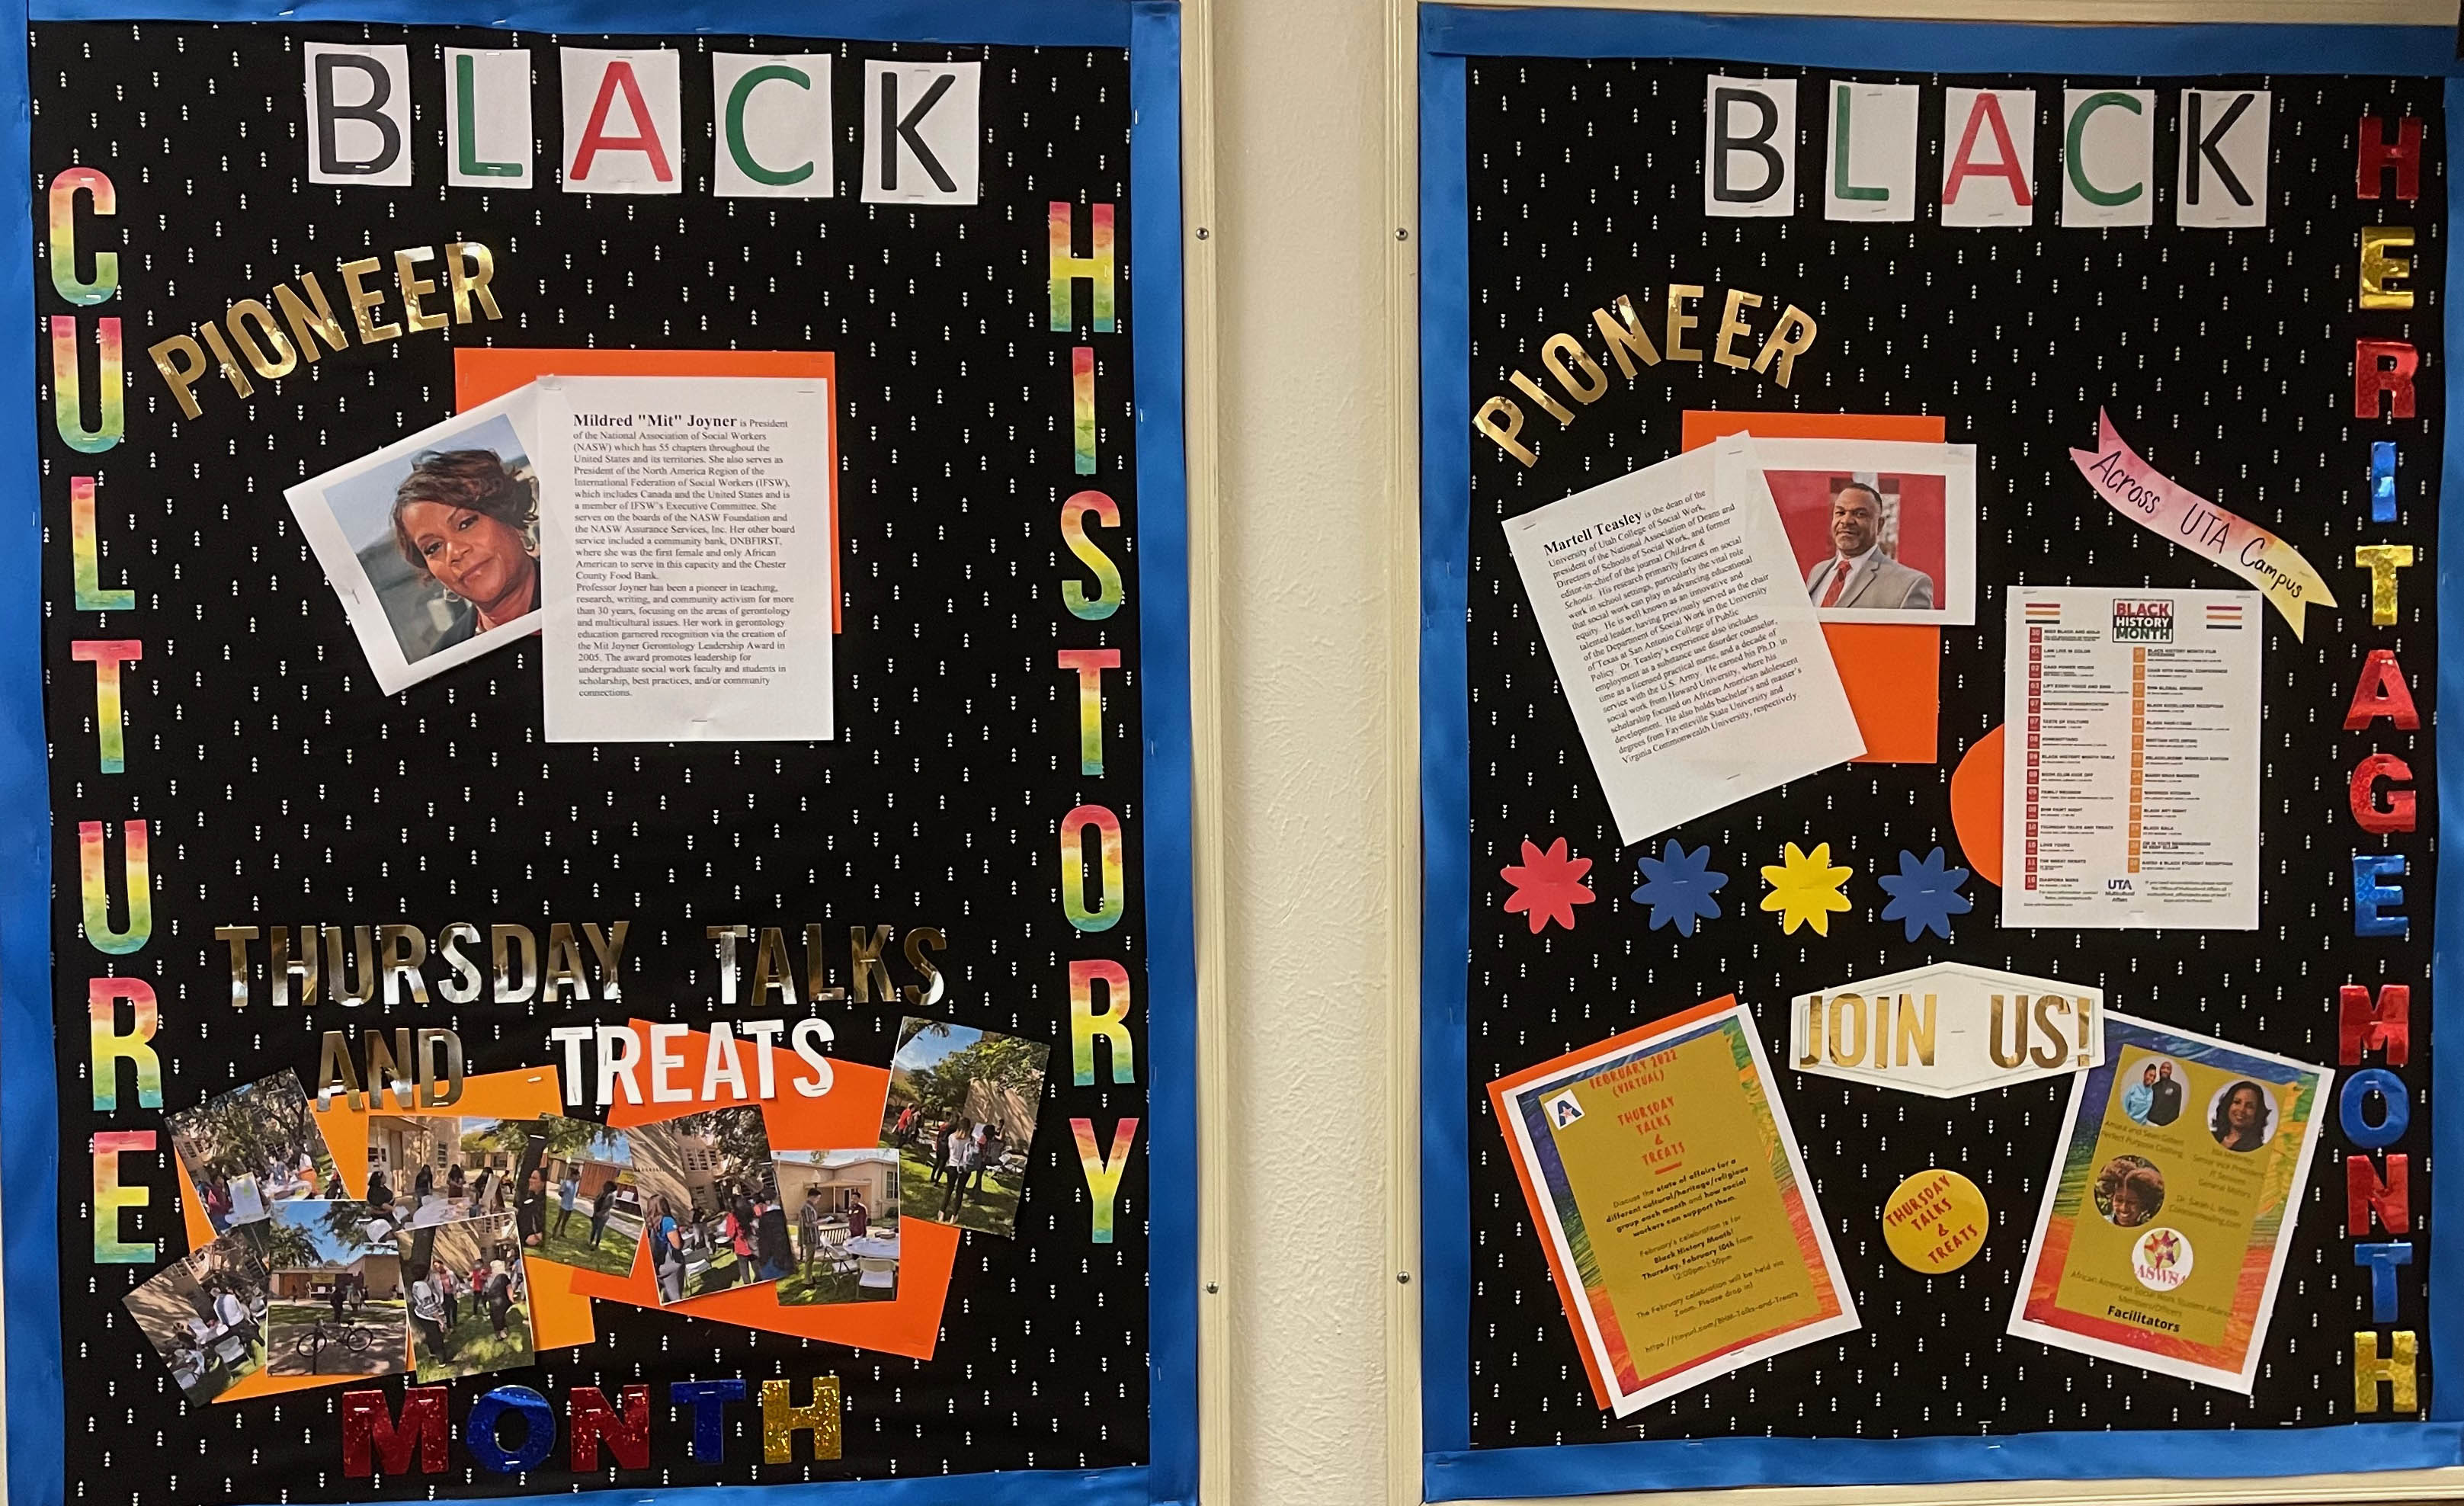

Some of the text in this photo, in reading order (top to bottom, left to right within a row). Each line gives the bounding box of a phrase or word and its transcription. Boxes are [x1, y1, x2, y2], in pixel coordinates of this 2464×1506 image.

[315, 53, 957, 192] BLACK
[1714, 85, 2254, 206] BLACK
[148, 242, 503, 420] PIONEER
[1472, 284, 1816, 468] PIONEER
[573, 414, 633, 427] Mildred
[638, 414, 682, 427] "Mit"
[687, 414, 738, 430] Joyner
[749, 418, 788, 428] President
[573, 442, 771, 454] (NASW) which has 55 chapters throughout the
[574, 477, 629, 487] International
[630, 478, 676, 488] Federation
[678, 477, 688, 487] of
[688, 478, 716, 487] Social
[717, 478, 755, 488] Workers
[575, 524, 589, 534] the
[590, 524, 623, 534] NASW
[624, 525, 669, 534] Assurance
[729, 524, 746, 534] Her
[747, 524, 770, 534] other
[771, 524, 796, 534] board
[575, 536, 606, 545] service
[607, 536, 645, 545] included
[653, 536, 702, 547] community
[1543, 527, 1593, 556] Martell
[1593, 511, 1642, 537] Teasley
[1652, 506, 1665, 515] the
[1665, 499, 1684, 511] dean
[1684, 493, 1693, 503] of
[1693, 491, 1706, 499] the
[2090, 450, 2302, 598] Across UTA Campus
[2342, 117, 2422, 937] HERITAGE
[575, 570, 608, 582] County
[609, 571, 633, 580] Food
[2116, 603, 2169, 616] BLACK
[2116, 617, 2169, 627] HISTORY
[2116, 628, 2169, 639] MONTH
[1606, 708, 1629, 724] social
[1628, 702, 1649, 714] work
[1649, 695, 1668, 707] from
[1667, 681, 1699, 700] Howard
[1741, 658, 1765, 671] where
[1764, 653, 1777, 664] his
[50, 167, 163, 1264] CULTURE
[1049, 201, 1139, 1243] HISTORY
[1618, 684, 1784, 755] degrees from Fayetteville State University and
[2108, 880, 2132, 890] UTA
[214, 921, 947, 1007] THURSDAY TALKS
[1799, 993, 2091, 1069] JOIN US!
[316, 1017, 835, 1113] AND TREATS
[1589, 1049, 1677, 1089] FEBRUARY 2022
[1612, 1069, 1665, 1097] (VIRTUAL)
[1617, 1097, 1674, 1126] THURSDAY
[1636, 1114, 1671, 1135] TALKS
[1642, 1142, 1685, 1165] TREATS
[1606, 1167, 1748, 1222] different cultural/heritage/religious
[1656, 1181, 1677, 1192] state
[1678, 1174, 1687, 1184] of
[1689, 1167, 1716, 1180] affairs
[2339, 985, 2418, 1413] MONTH
[1616, 1177, 1747, 1233] group each month and how social
[1633, 1222, 1665, 1237] workers
[1666, 1216, 1681, 1225] can
[1683, 1203, 1713, 1219] support
[1886, 1174, 1950, 1226] THURSDAY
[1911, 1198, 1952, 1231] TALKS
[1654, 1251, 1676, 1264] Black
[1676, 1241, 1705, 1255] History
[1682, 1249, 1717, 1265] February
[1928, 1224, 1978, 1264] TREATS
[1651, 1298, 1684, 1313] February
[1728, 1274, 1741, 1284] will
[1754, 1263, 1771, 1274] held
[1697, 1294, 1723, 1308] Please
[1725, 1287, 1742, 1298] drop
[2107, 1305, 2180, 1332] Facilitators
[342, 1376, 842, 1478] MONTH
